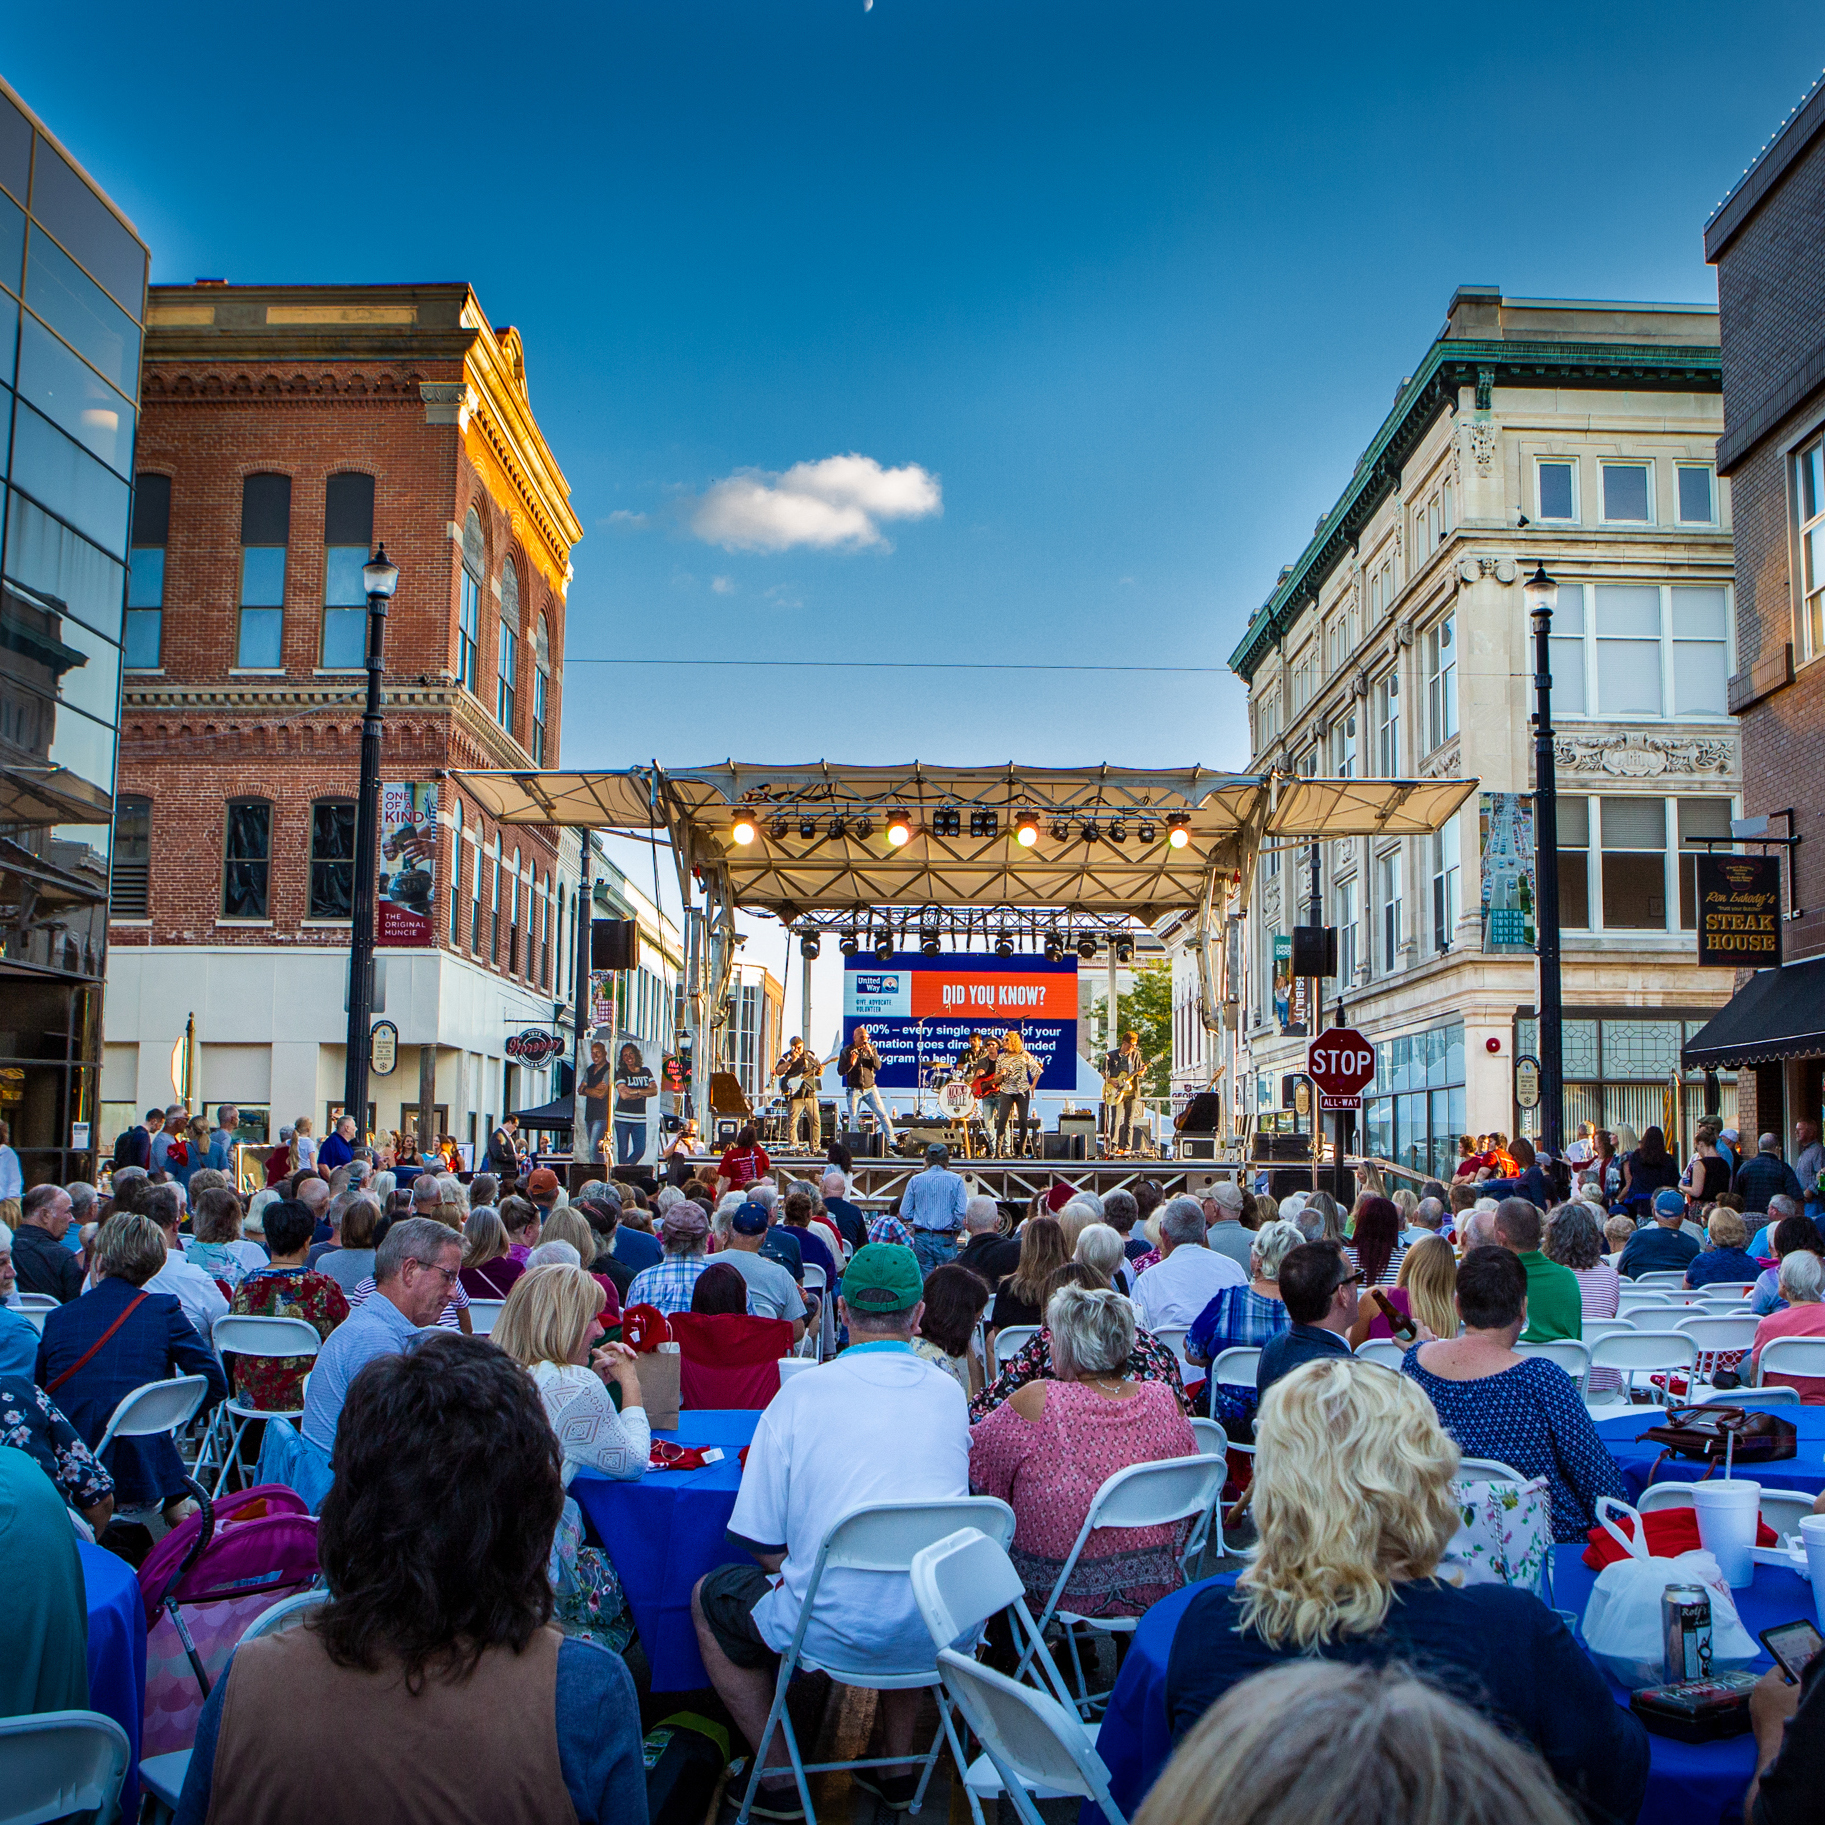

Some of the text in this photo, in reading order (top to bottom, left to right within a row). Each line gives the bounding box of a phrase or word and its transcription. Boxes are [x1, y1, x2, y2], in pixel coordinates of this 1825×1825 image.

[385, 791, 410, 801] ONE
[385, 801, 413, 810] OF A
[385, 811, 425, 823] KIND
[1705, 891, 1776, 907] Ron Lahody's
[1492, 910, 1524, 919] DWNTWN
[1492, 918, 1524, 927] DWNTWN
[1706, 913, 1775, 931] STEAK
[1492, 926, 1524, 935] DWNTWN
[1492, 935, 1524, 943] DWNTWN
[1706, 933, 1776, 951] HOUSE
[858, 977, 881, 985] United
[867, 985, 880, 993] Way
[943, 985, 1046, 1006] DID YOU KNOW?
[902, 1026, 933, 1037] every
[936, 1025, 970, 1037] single
[1021, 1026, 1033, 1036] of
[1035, 1028, 1061, 1038] your
[916, 1041, 944, 1051] goes
[932, 1053, 957, 1065] help
[1312, 1049, 1371, 1075] STOP
[627, 1076, 649, 1087] LOVE
[948, 1095, 966, 1106] BELLE
[1323, 1098, 1359, 1107] ALL-WAY
[1681, 1606, 1707, 1620] Rolf's
